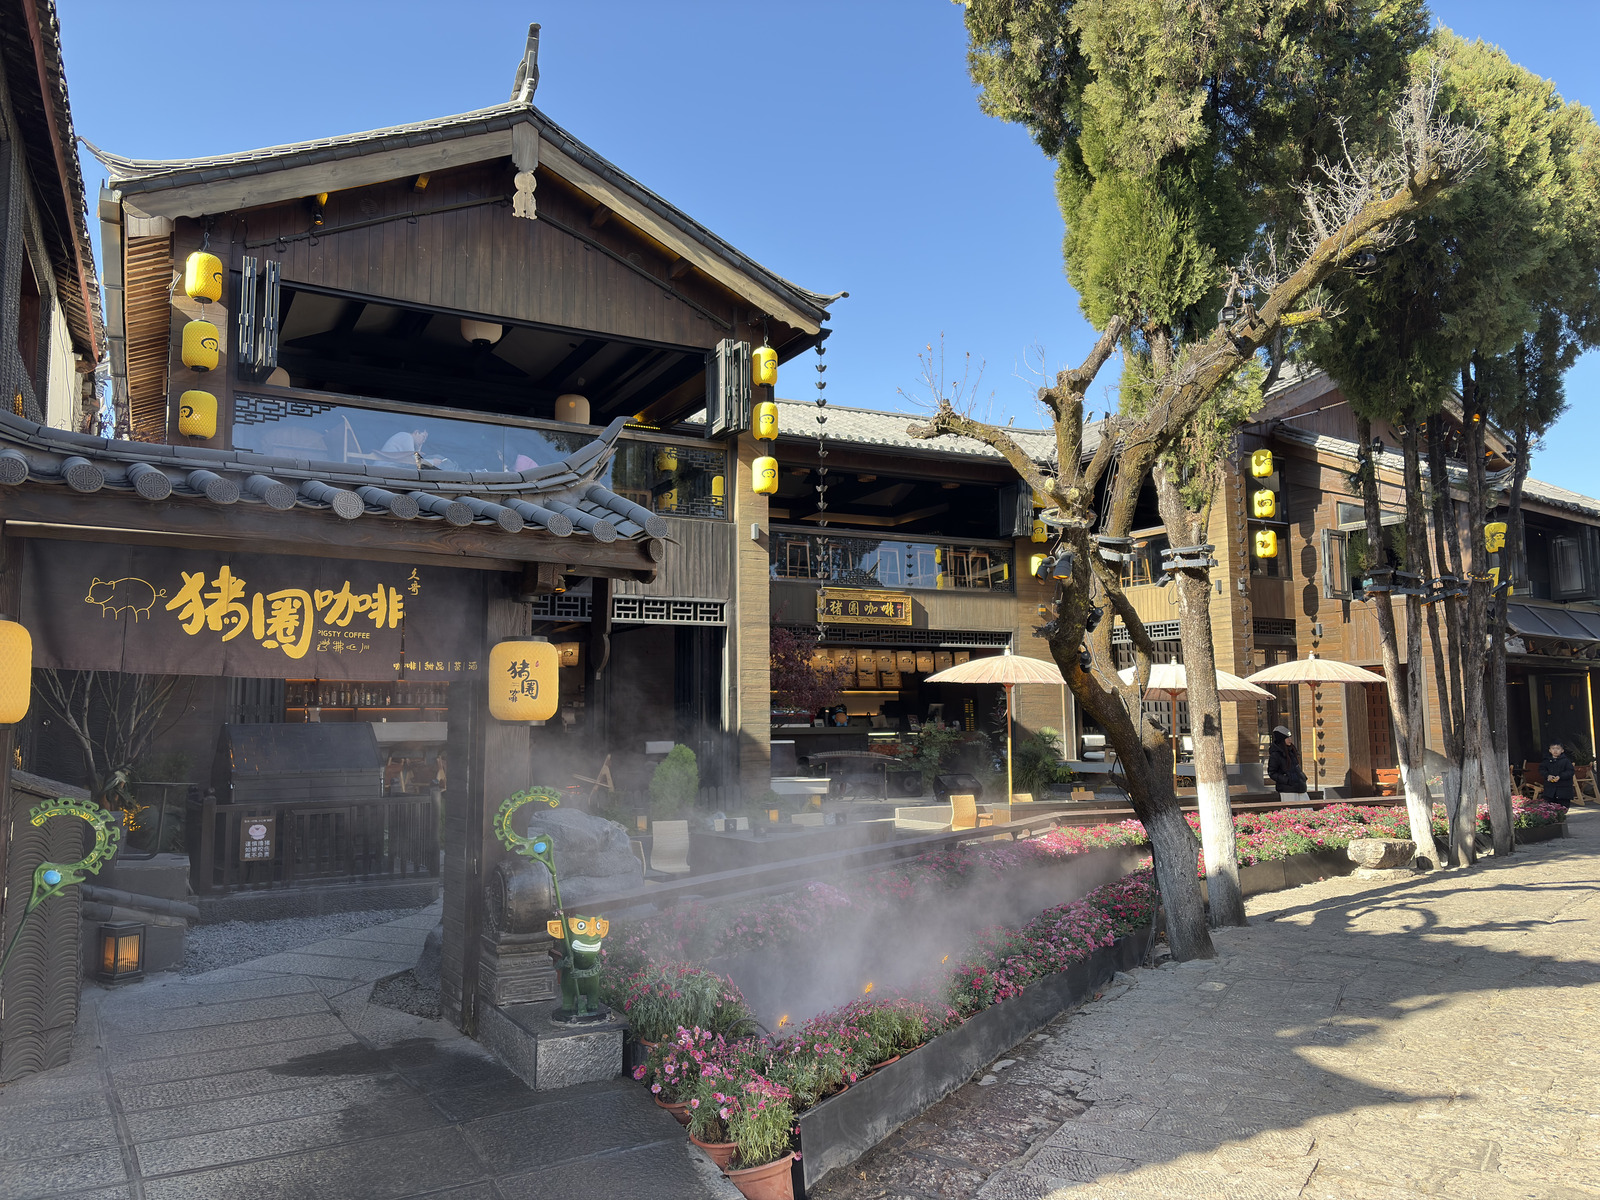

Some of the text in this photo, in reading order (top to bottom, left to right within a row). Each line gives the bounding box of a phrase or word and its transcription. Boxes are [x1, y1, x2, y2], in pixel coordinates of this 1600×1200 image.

[165, 565, 404, 660] 猪圈咖啡
[317, 629, 371, 640] PIGSTY COFFEE
